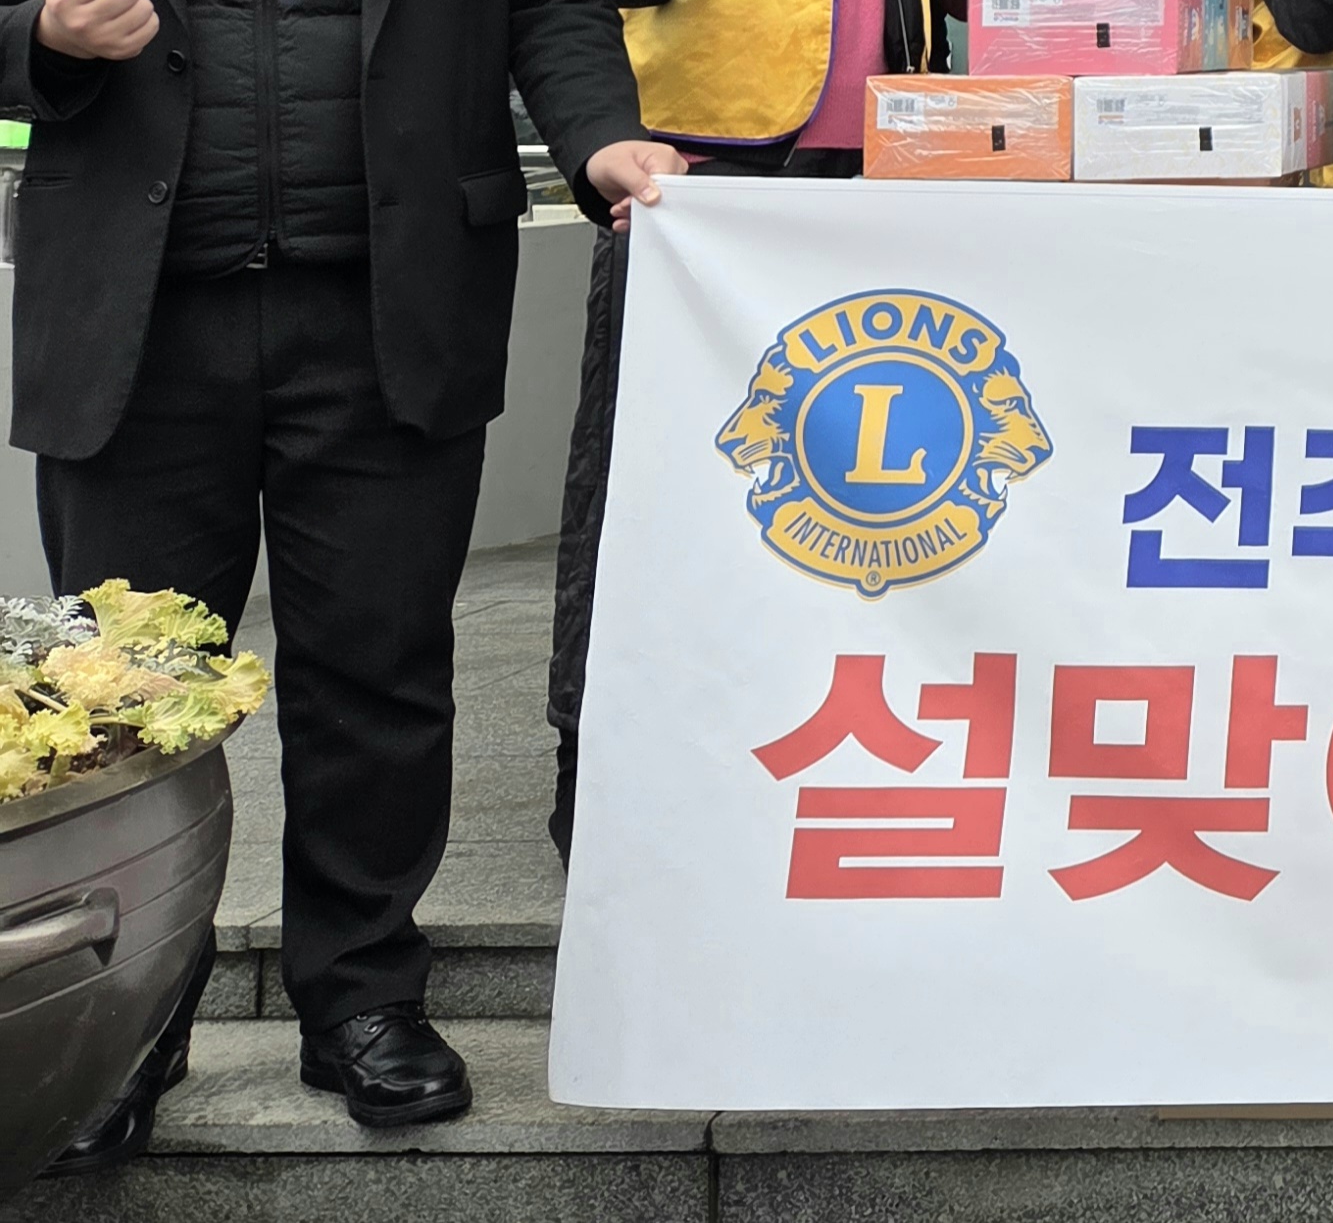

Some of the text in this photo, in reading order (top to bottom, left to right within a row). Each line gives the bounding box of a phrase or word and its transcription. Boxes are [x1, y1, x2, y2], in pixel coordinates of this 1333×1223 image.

[798, 301, 989, 366] LIONS
[845, 384, 928, 485] L
[783, 510, 968, 569] INTERNATIONAL
